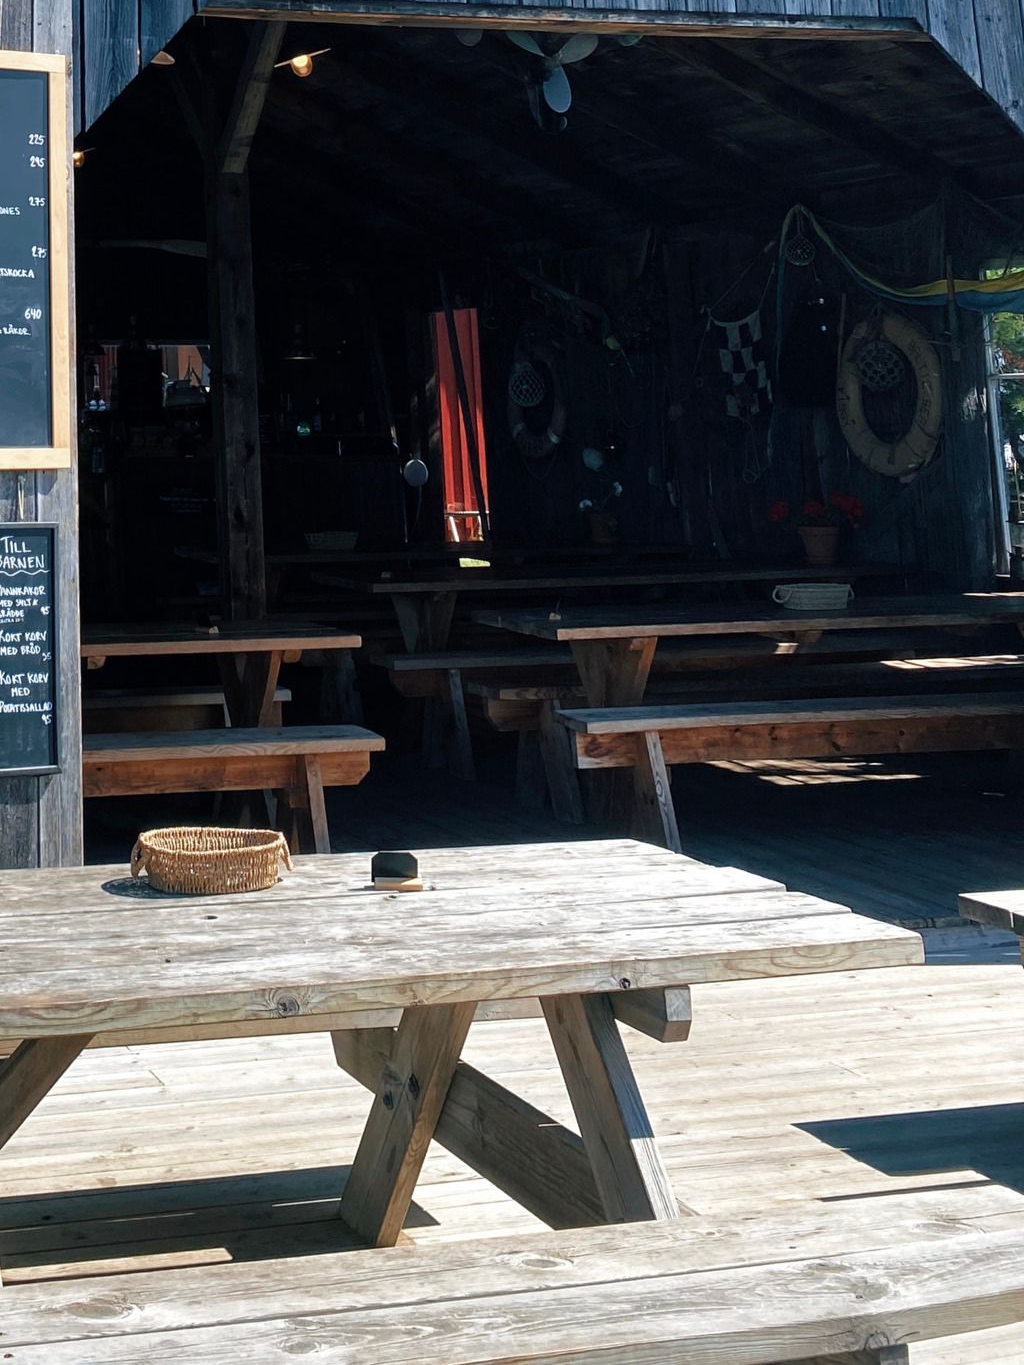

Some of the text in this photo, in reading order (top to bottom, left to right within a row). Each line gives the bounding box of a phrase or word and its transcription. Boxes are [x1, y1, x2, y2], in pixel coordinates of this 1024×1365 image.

[28, 133, 45, 145] 225
[28, 196, 46, 206] 275
[24, 307, 42, 320] 640
[0, 535, 32, 553] TILL
[25, 631, 47, 641] KORV
[0, 646, 18, 656] MED
[27, 672, 49, 684] KORV
[11, 687, 31, 697] MED
